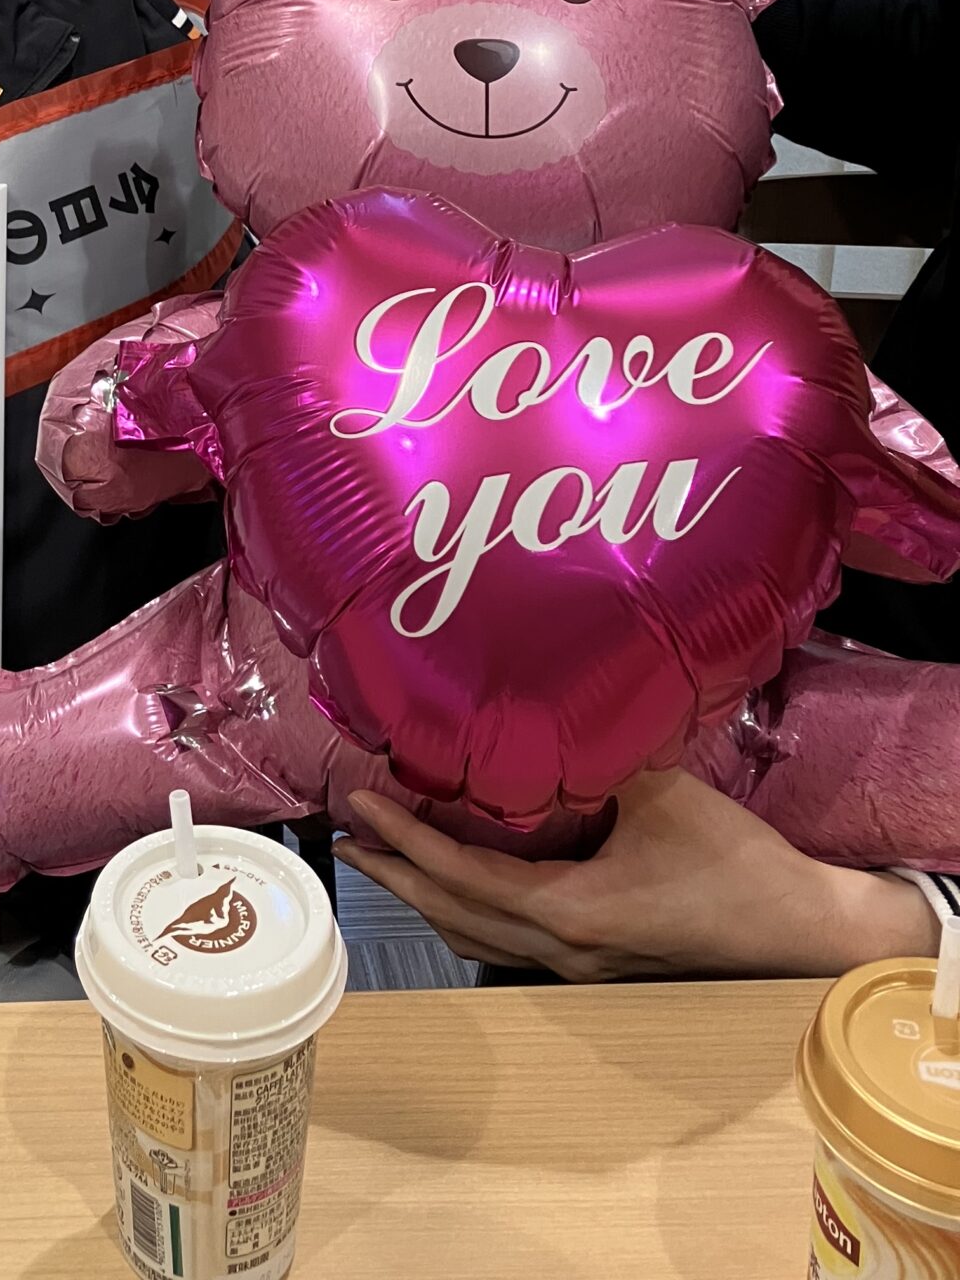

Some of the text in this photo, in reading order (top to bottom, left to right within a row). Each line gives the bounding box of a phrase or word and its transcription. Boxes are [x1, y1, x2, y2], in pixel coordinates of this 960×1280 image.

[7, 162, 159, 265] 今日の
[330, 281, 774, 439] Love
[390, 458, 742, 638] you
